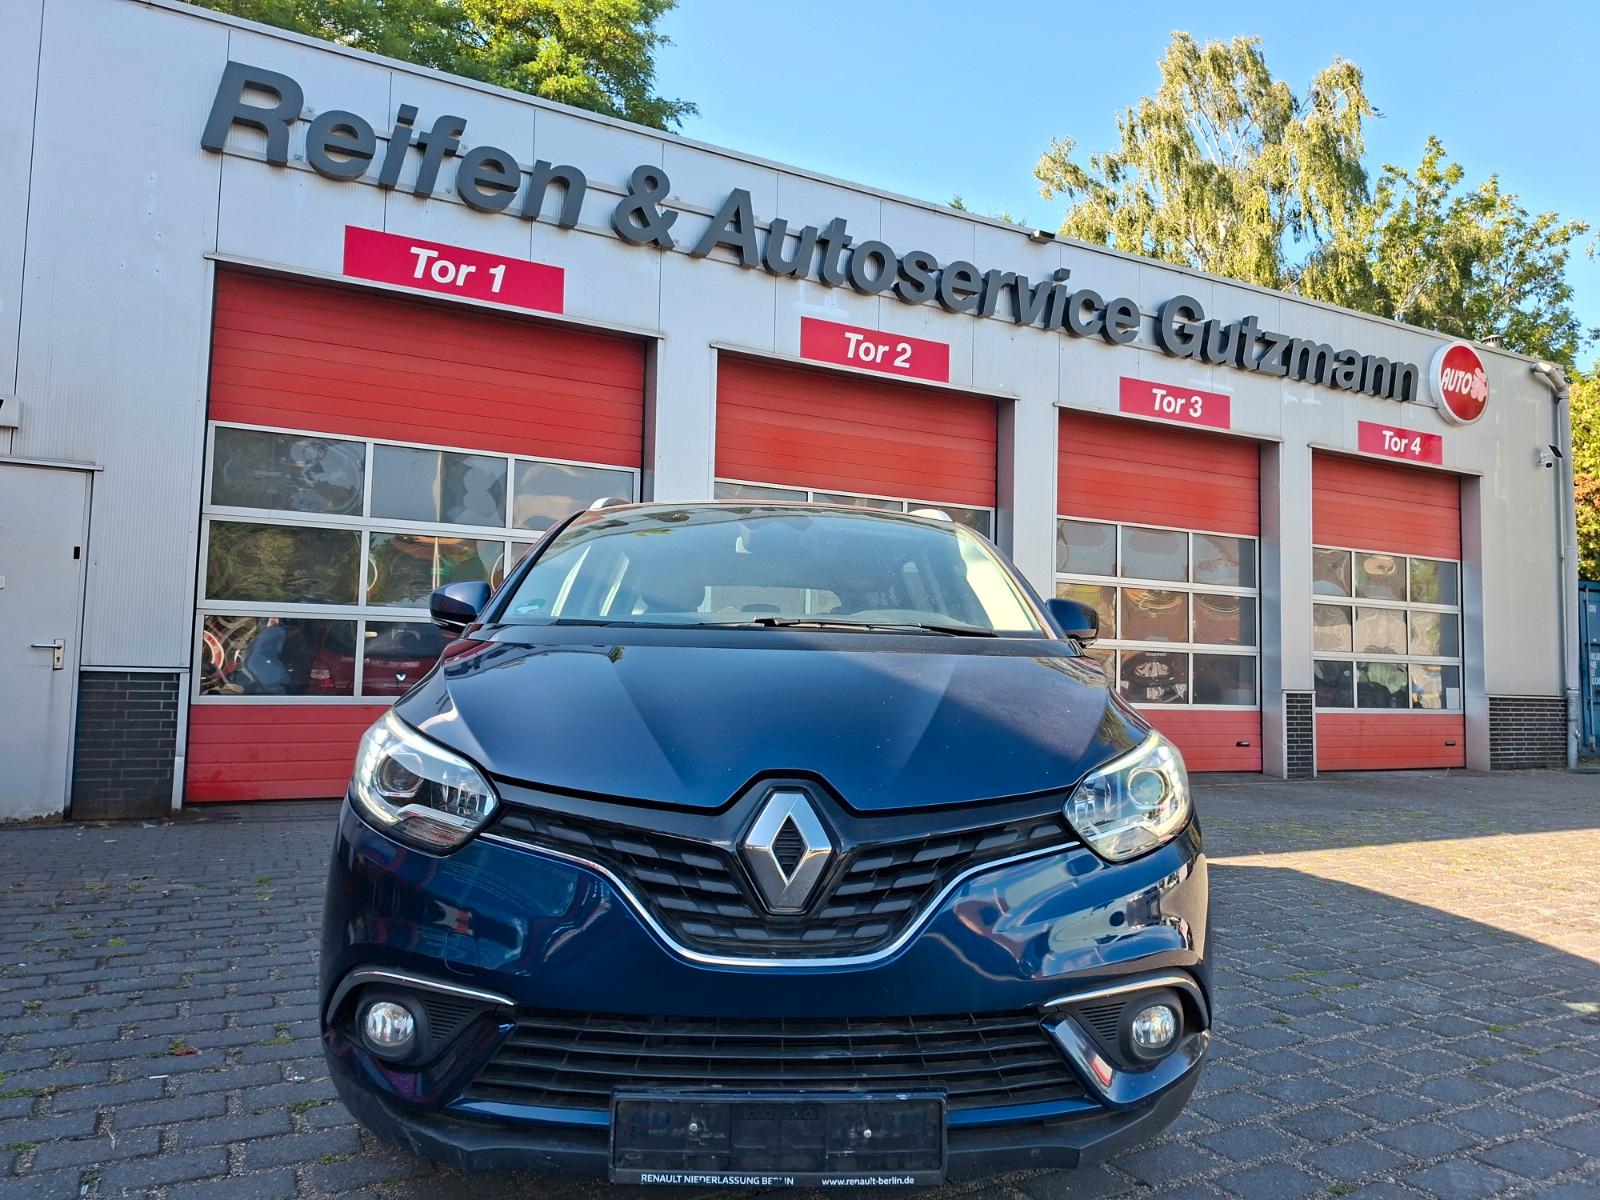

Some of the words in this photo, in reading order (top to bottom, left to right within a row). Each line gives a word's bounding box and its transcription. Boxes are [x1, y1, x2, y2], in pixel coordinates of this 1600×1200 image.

[201, 60, 587, 229] Reifen
[611, 164, 679, 250] &
[690, 187, 1140, 345] Autoservice
[1154, 295, 1419, 402] Gutzmann
[410, 246, 475, 288] Tor
[489, 264, 506, 293] 1
[844, 332, 889, 364] Tor
[894, 343, 912, 368] 2
[1441, 368, 1472, 394] AUTO
[1152, 388, 1188, 414] Tor
[1189, 396, 1202, 418] 3
[1382, 430, 1407, 453] Tor
[1410, 438, 1421, 455] 4
[641, 1174, 682, 1184] RENAULT
[683, 1175, 760, 1185] NIEDERLASSUNG
[761, 1177, 794, 1186] BEIN
